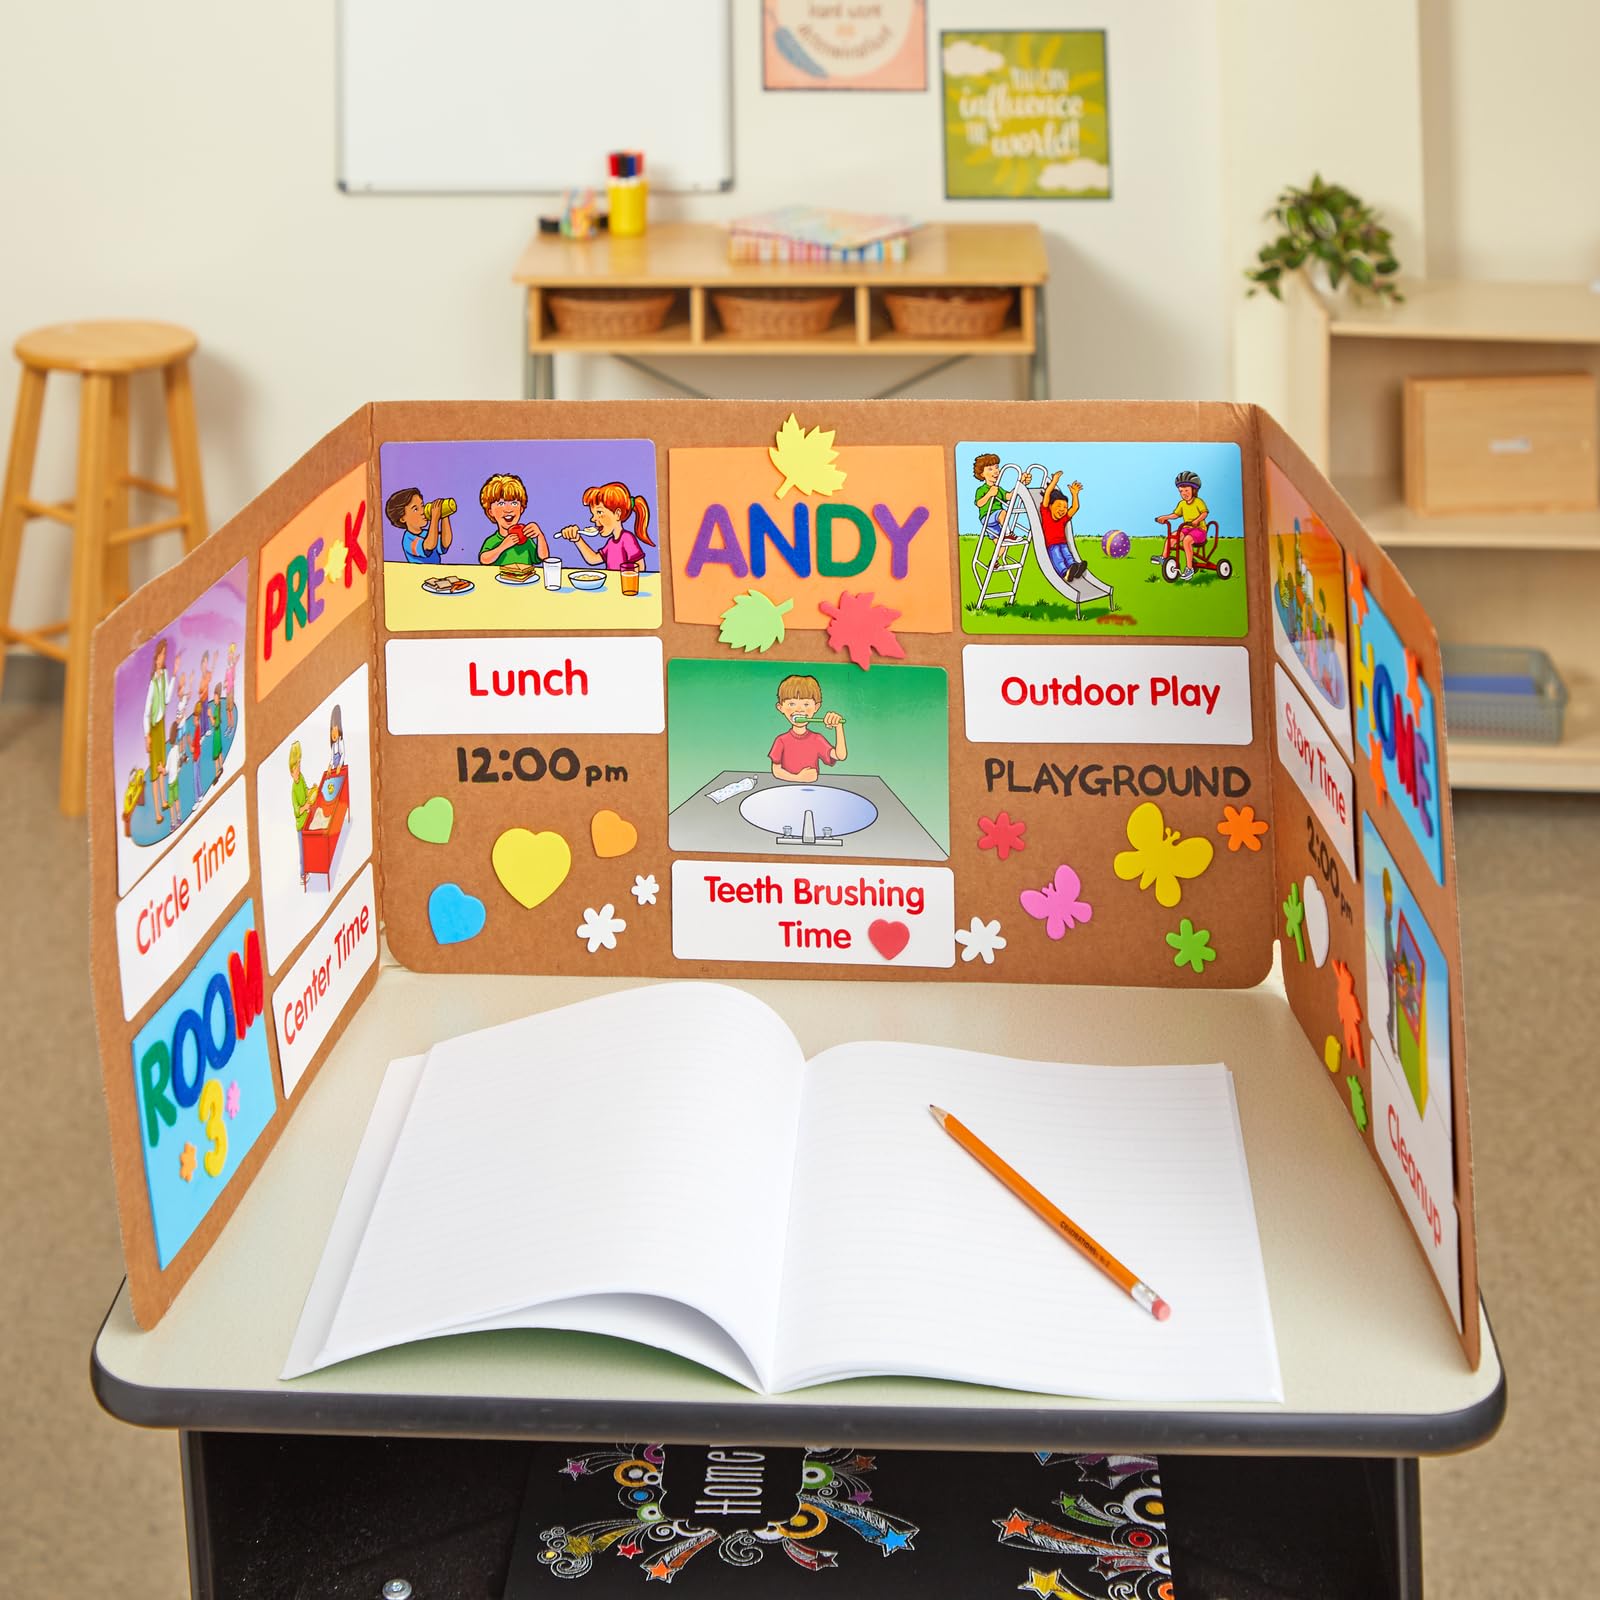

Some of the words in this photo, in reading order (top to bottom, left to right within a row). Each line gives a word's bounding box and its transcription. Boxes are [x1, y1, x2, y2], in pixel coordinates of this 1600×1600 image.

[685, 502, 930, 579] ANDY
[469, 658, 589, 696] Lunch
[1001, 675, 1140, 706] Outdoor
[1150, 675, 1221, 715] Play
[1285, 702, 1315, 784] Story
[1317, 748, 1346, 825] Time
[1353, 623, 1433, 838] HOME
[984, 758, 1252, 797] PLAYGROUND
[136, 875, 190, 956] Circle
[193, 825, 236, 893] Time
[703, 875, 783, 904] Teeth
[793, 877, 925, 915] Brushing
[1307, 815, 1340, 899] 2:00
[284, 955, 332, 1046] Center
[334, 904, 370, 970] Time
[778, 920, 852, 950] Time
[140, 929, 264, 1148] ROOM
[199, 1078, 228, 1178] 3
[1387, 1103, 1442, 1249] Cleanup
[694, 1444, 765, 1515] Home
